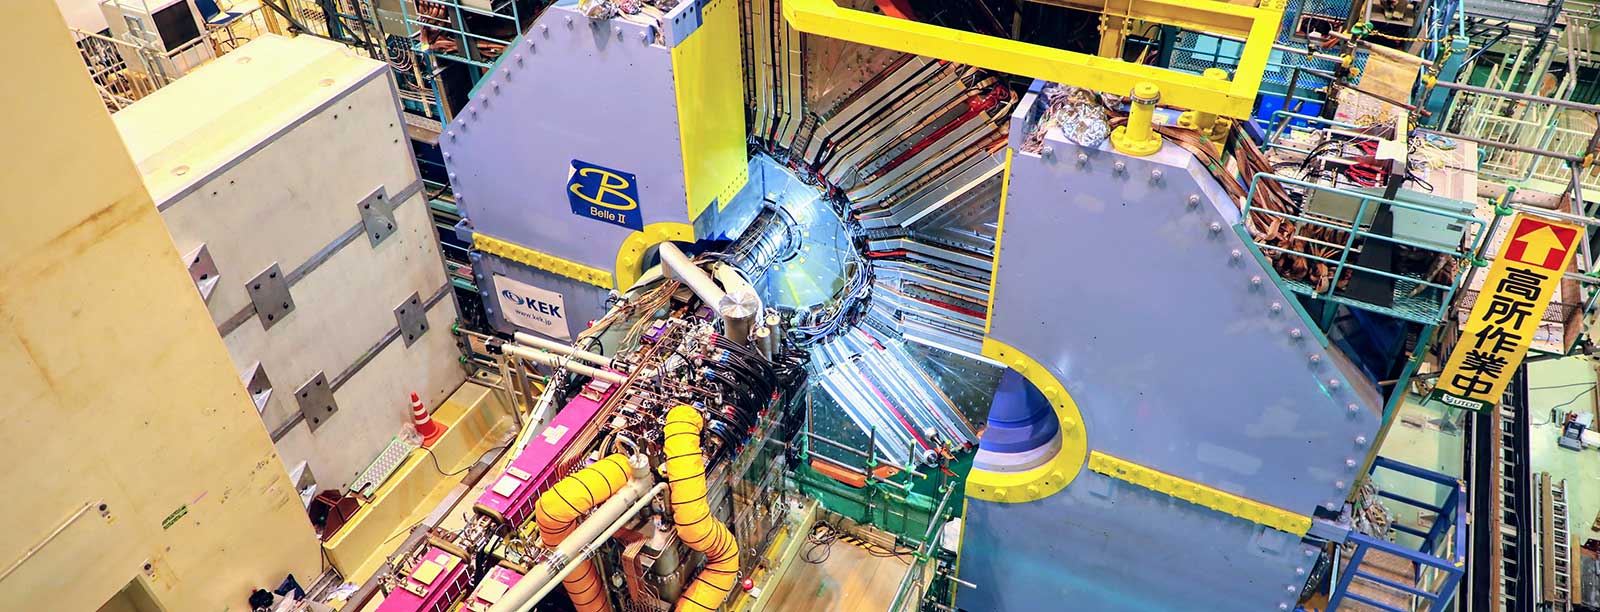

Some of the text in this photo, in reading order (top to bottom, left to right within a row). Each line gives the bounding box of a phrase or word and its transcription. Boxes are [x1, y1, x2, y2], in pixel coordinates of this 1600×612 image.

[590, 206, 615, 221] Belle
[525, 297, 562, 318] KEK
[515, 309, 552, 327] www.kek.jp
[1451, 266, 1549, 397] 高所作業中
